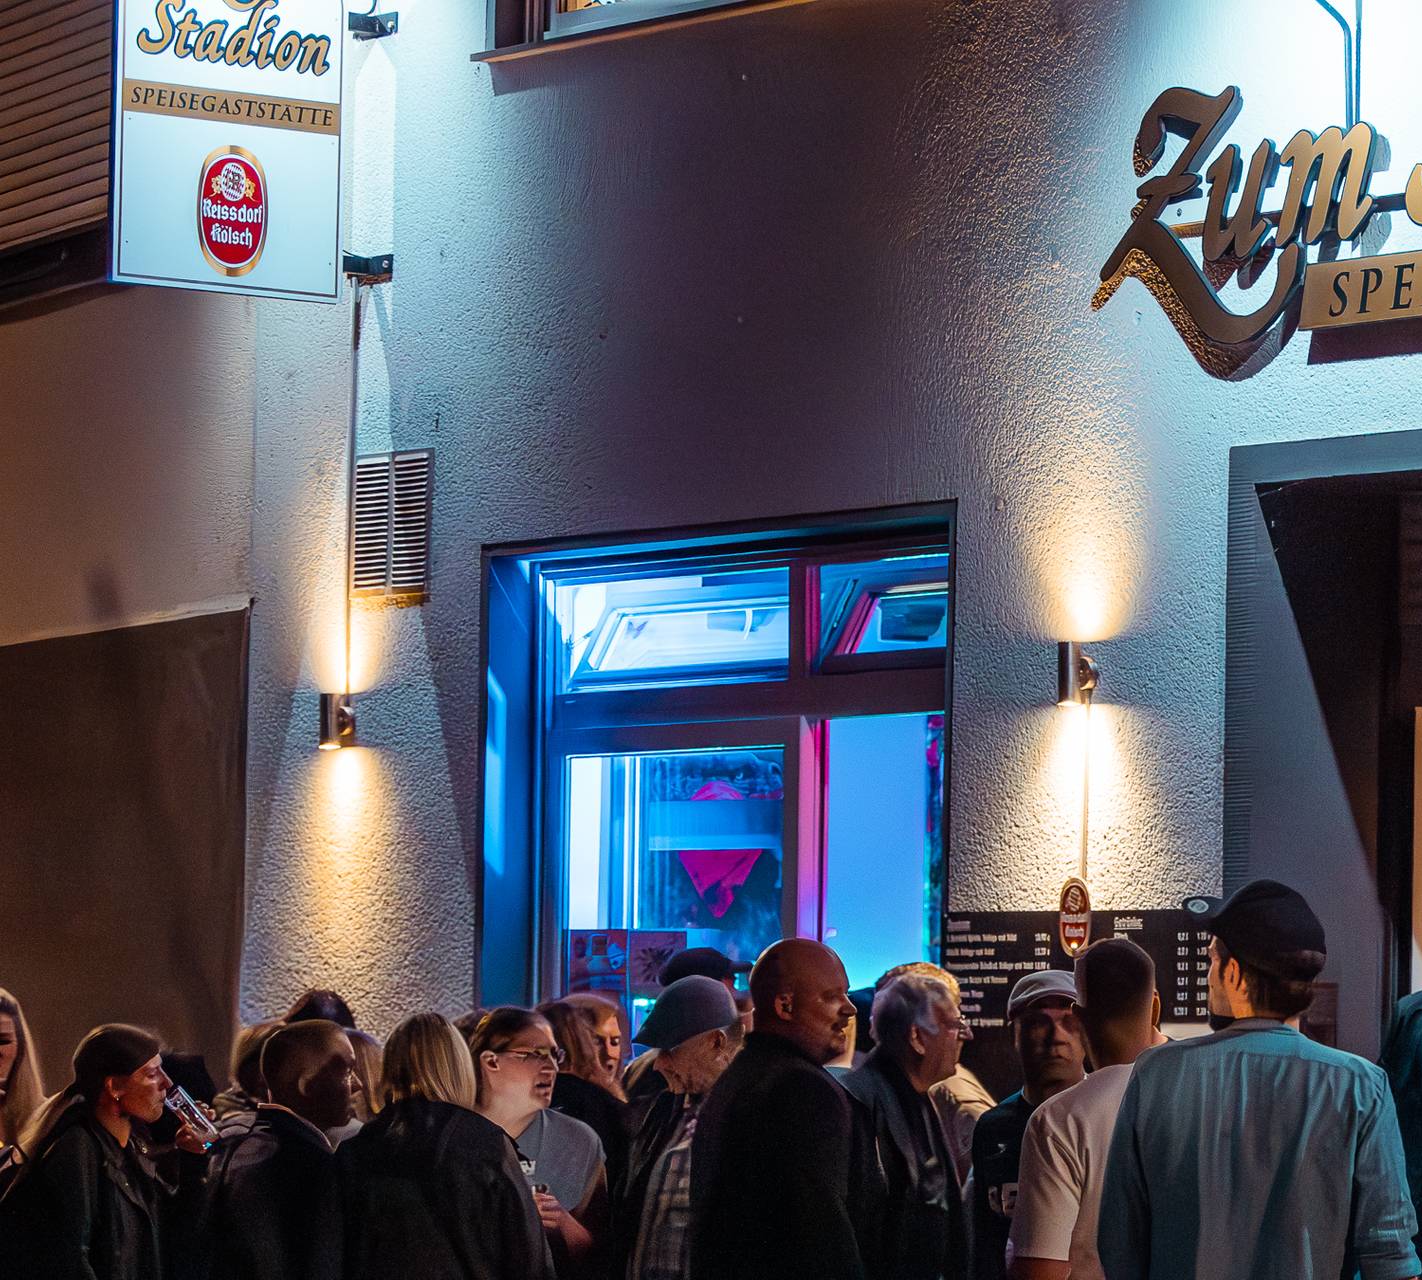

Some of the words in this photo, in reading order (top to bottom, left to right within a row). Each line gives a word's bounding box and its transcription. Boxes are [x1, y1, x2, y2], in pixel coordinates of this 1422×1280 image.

[136, 0, 331, 77] Stadion
[131, 86, 333, 127] SPEISEGASTSTÄTTE
[202, 198, 264, 223] Reissdorf
[1099, 85, 1375, 345] Zum
[211, 223, 253, 249] Kölsch
